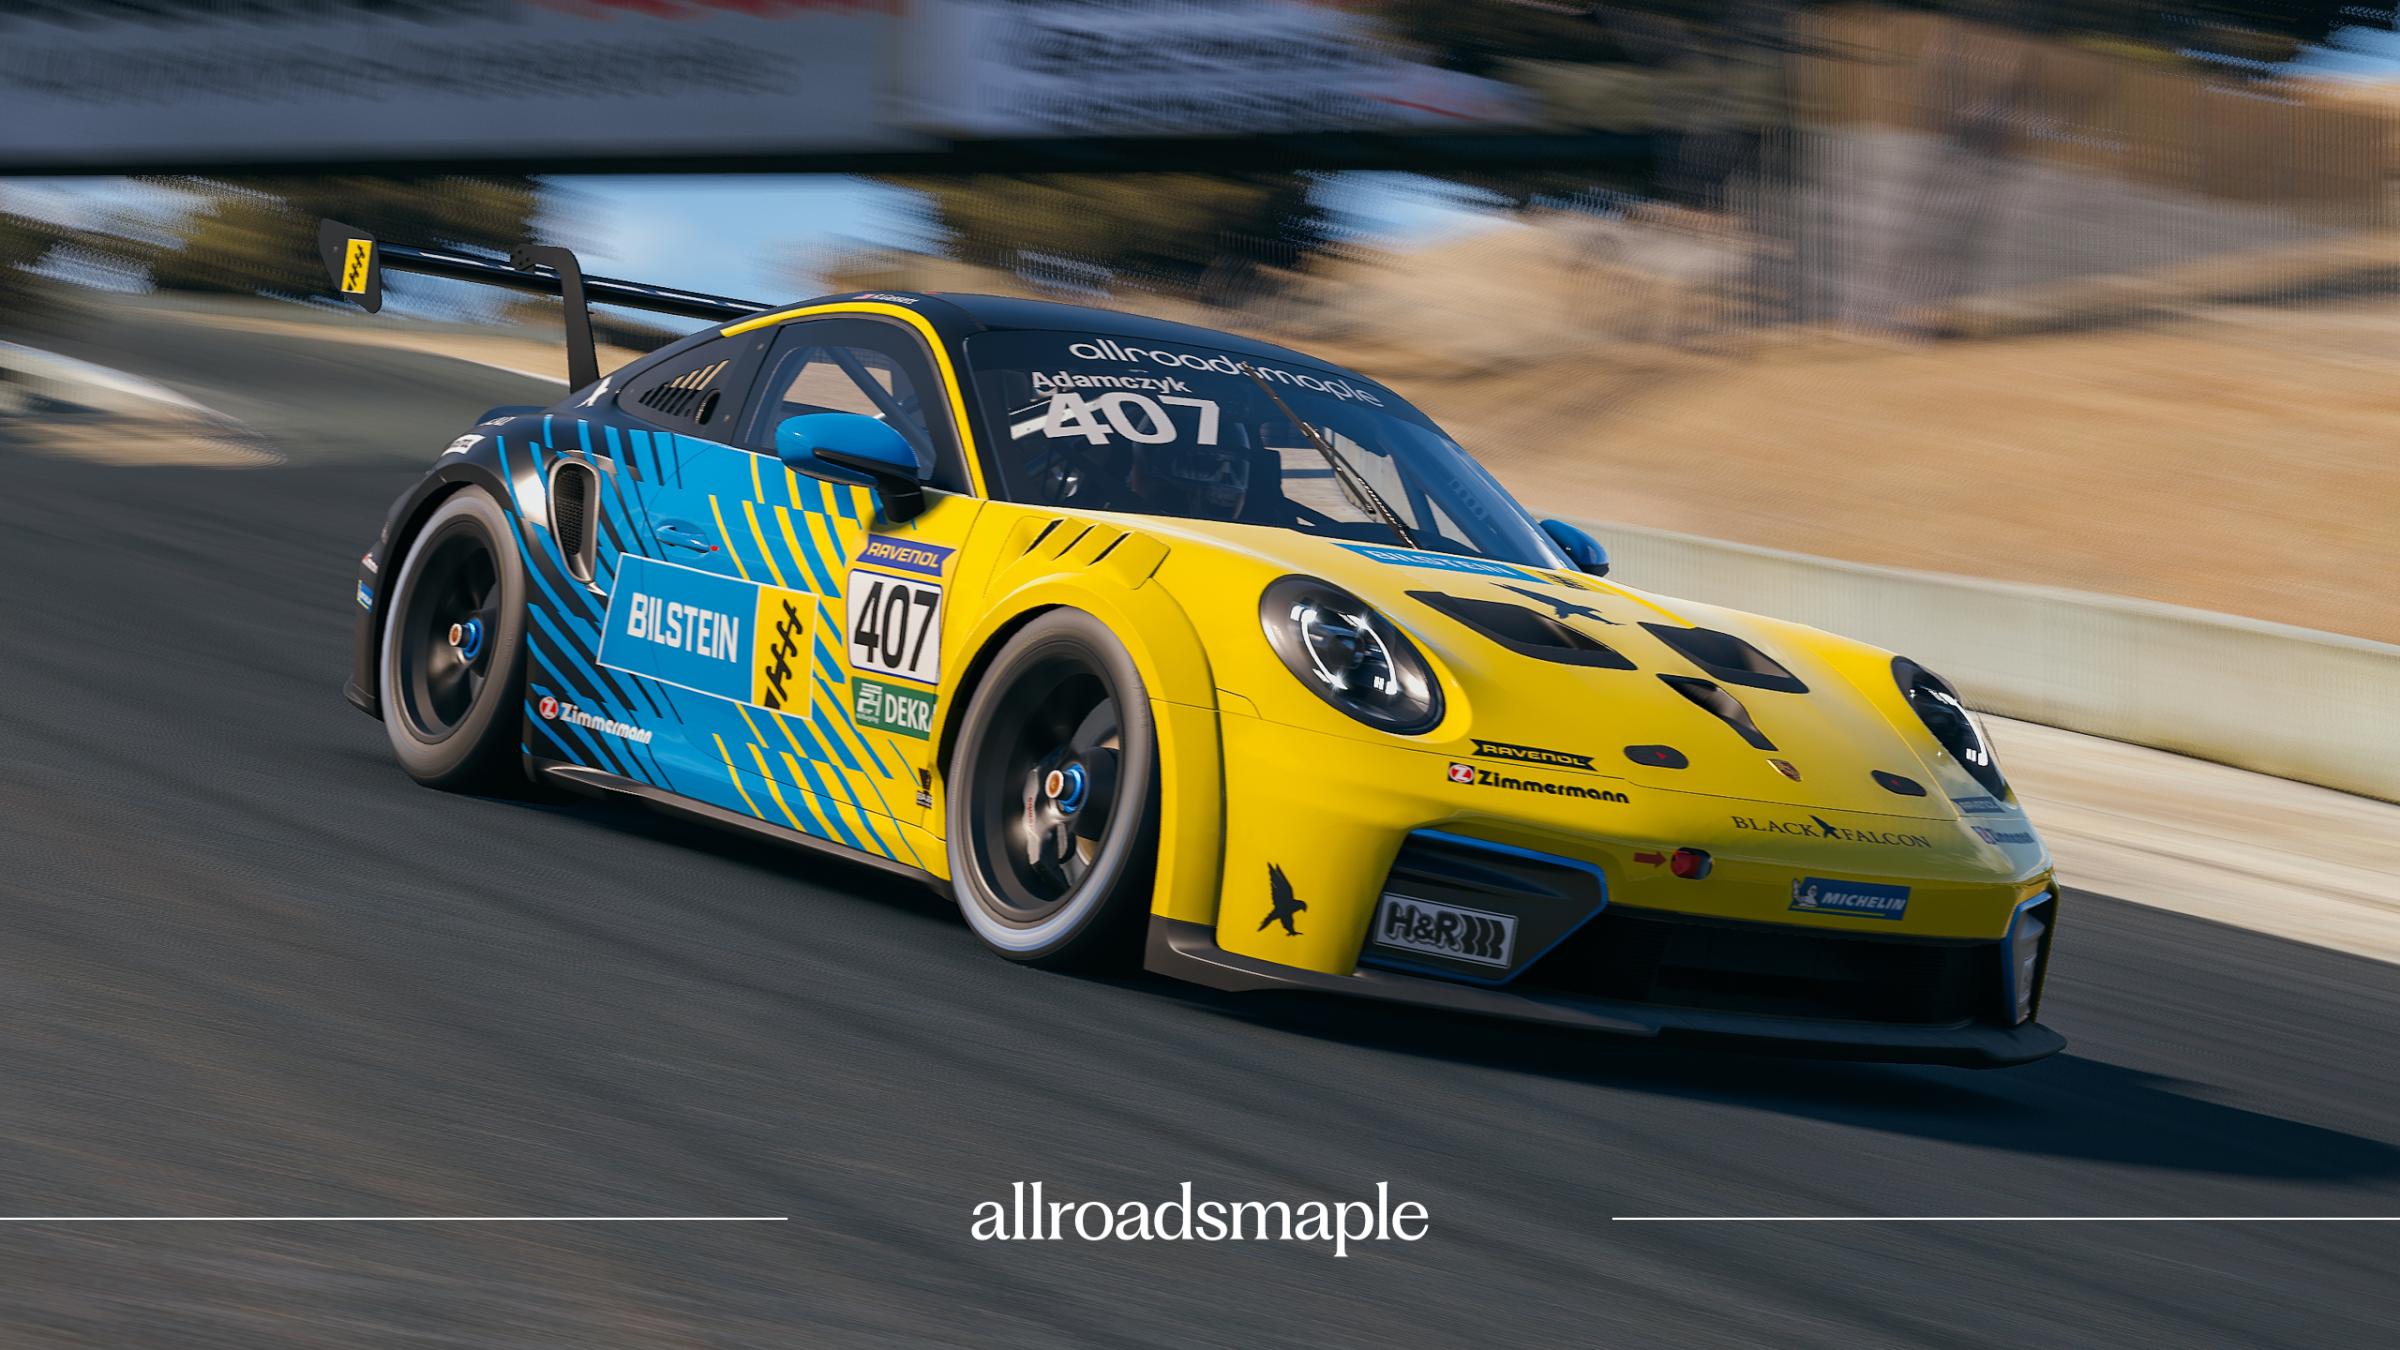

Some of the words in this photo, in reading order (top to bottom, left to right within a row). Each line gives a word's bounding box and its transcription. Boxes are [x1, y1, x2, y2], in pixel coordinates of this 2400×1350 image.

[1031, 371, 1192, 394] Adamczyk
[1068, 338, 1385, 408] allroadsmaple
[1043, 391, 1221, 446] 407
[866, 542, 940, 568] RAVENOL
[626, 592, 740, 663] BILSTEIN
[854, 581, 940, 672] 407
[560, 702, 653, 745] Zimmermann
[1483, 744, 1587, 767] RAVENOL
[1478, 769, 1630, 804] Zimmermann
[1731, 815, 1819, 838] BLACK
[1841, 828, 1932, 849] FALCON
[1821, 891, 1906, 911] MICHELIN
[1385, 901, 1461, 951] H&R
